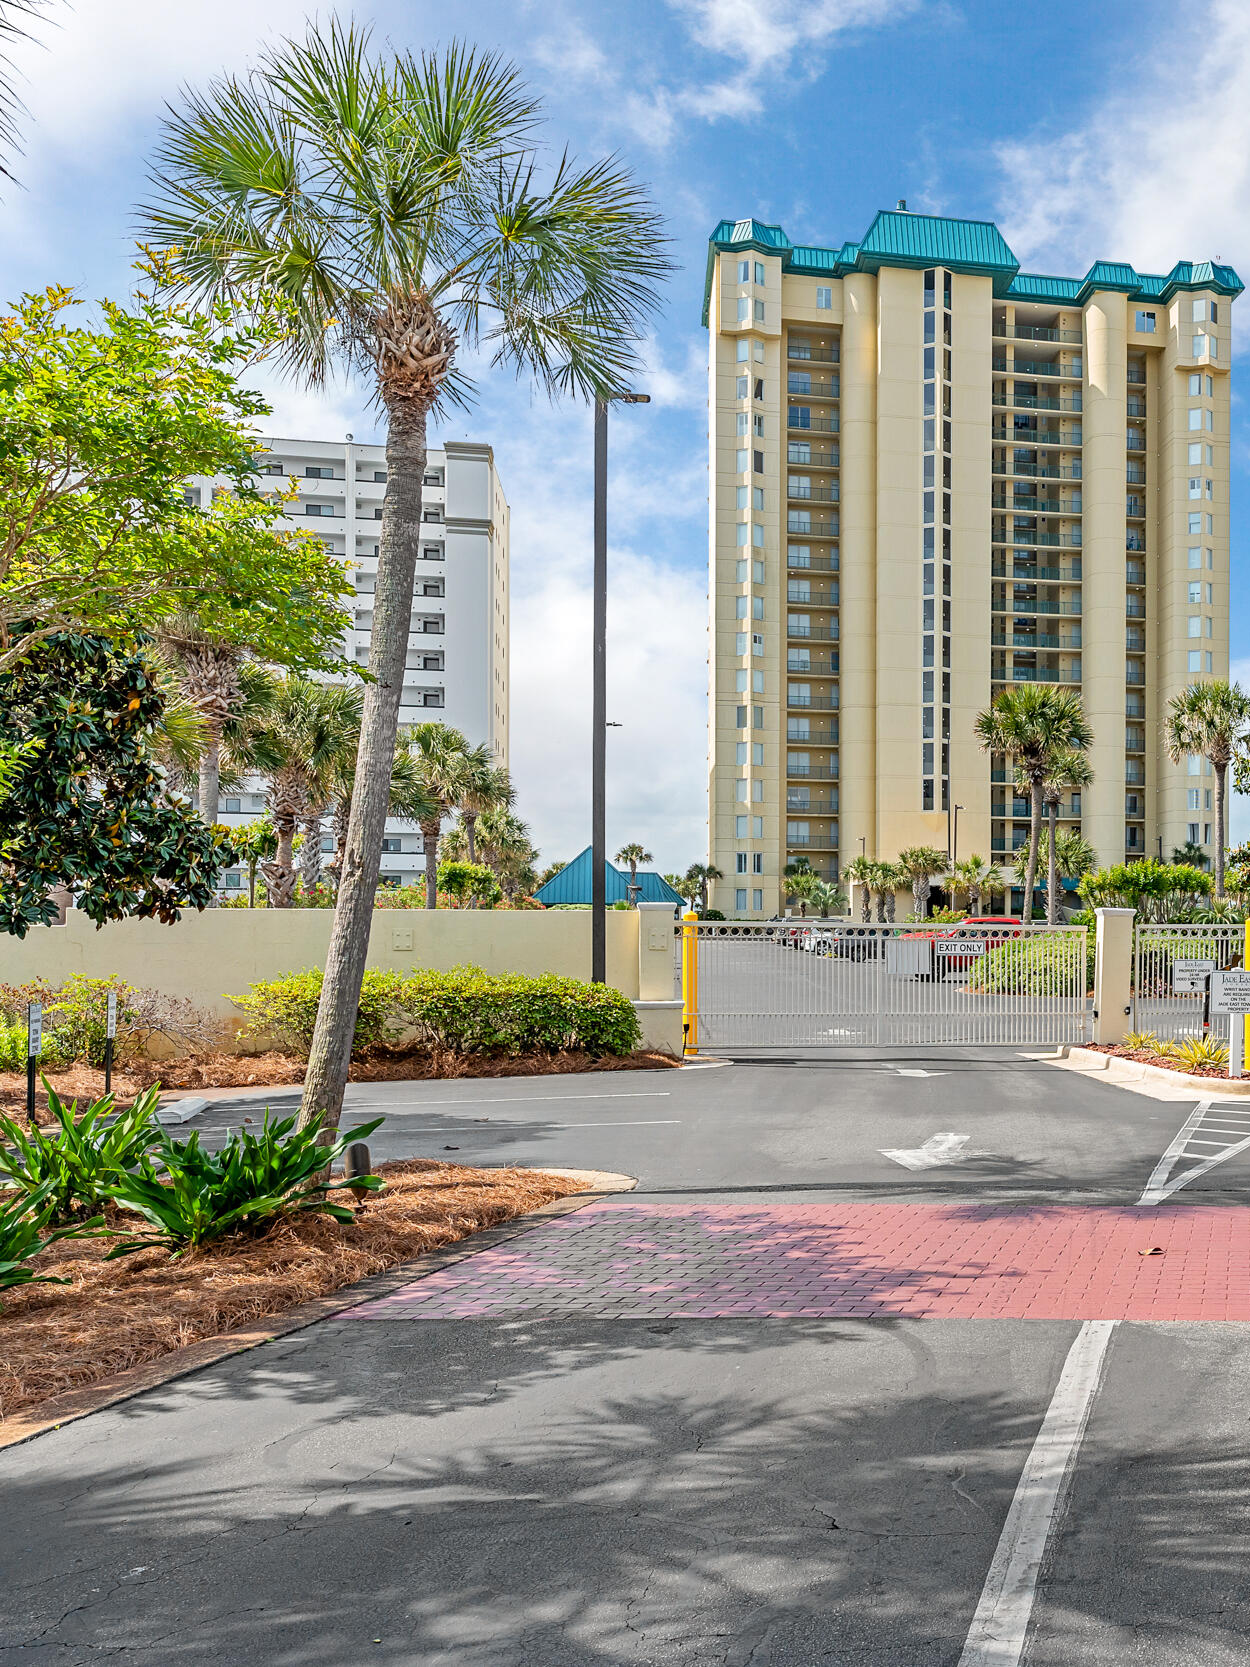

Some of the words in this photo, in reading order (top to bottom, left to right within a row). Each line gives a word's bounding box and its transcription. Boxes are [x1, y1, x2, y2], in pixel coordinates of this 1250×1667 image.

[939, 943, 958, 952] EXIT
[959, 943, 982, 952] ONLY
[1222, 974, 1238, 984] JADE
